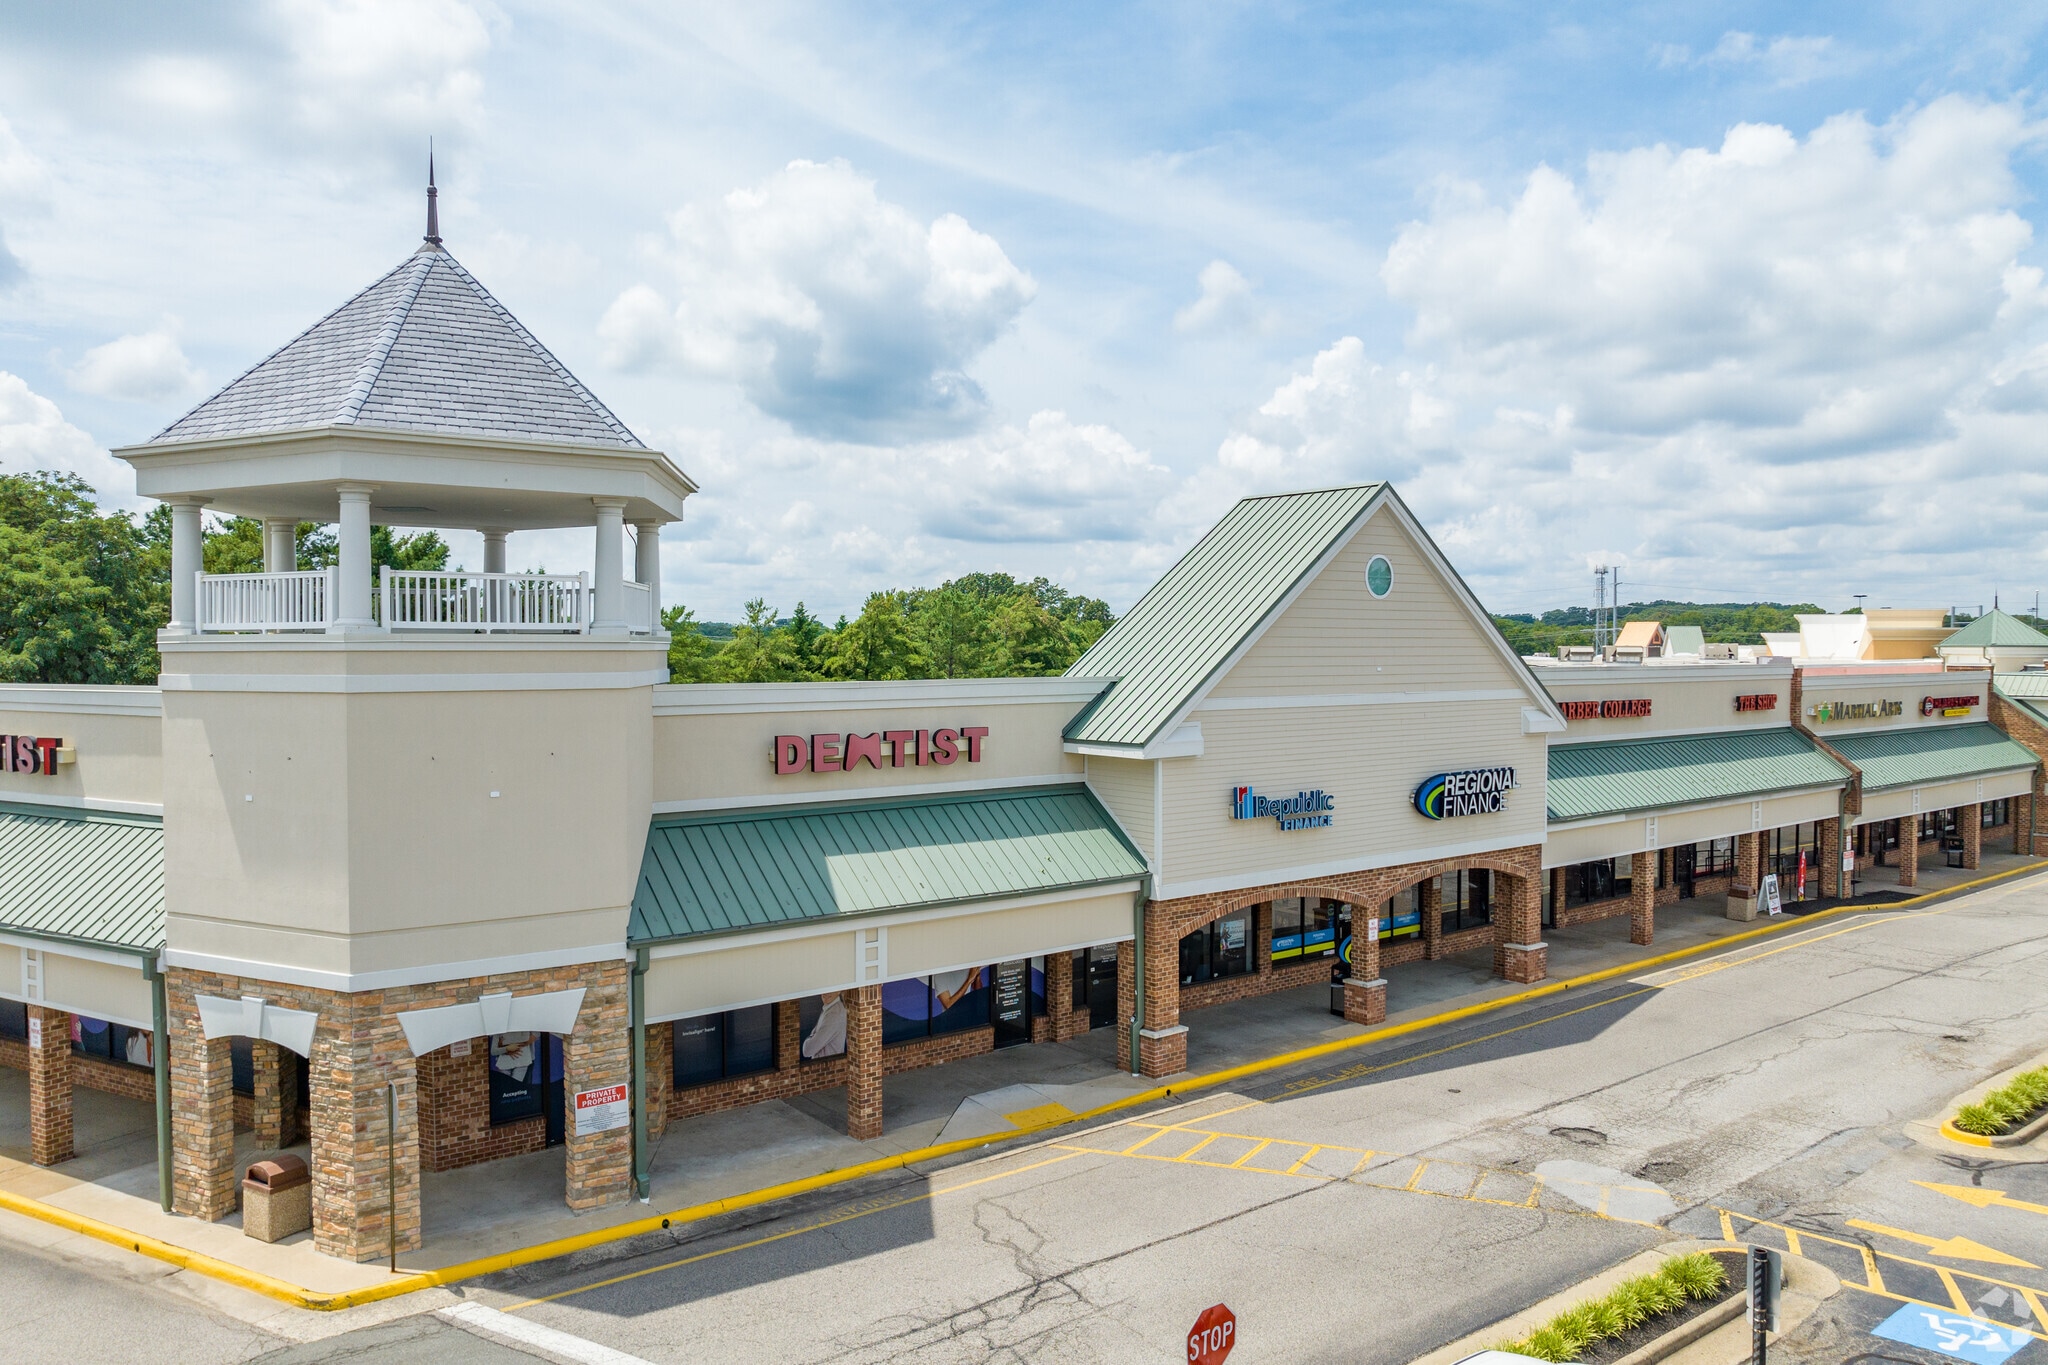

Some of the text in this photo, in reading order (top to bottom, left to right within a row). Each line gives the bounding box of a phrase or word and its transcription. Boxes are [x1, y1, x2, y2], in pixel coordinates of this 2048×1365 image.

[1560, 699, 1652, 720] ARBER COLLEGE
[1739, 694, 1777, 711] THE SHOP
[0, 735, 63, 776] IST
[774, 727, 989, 775] DENTIST
[1444, 768, 1521, 797] REGIONAL
[1257, 790, 1335, 821] Republic
[1443, 791, 1508, 818] FINANCE
[1282, 815, 1333, 831] FINANCE
[502, 1090, 528, 1098] Accepting
[582, 1094, 621, 1107] PROPERTY
[586, 1088, 617, 1100] PRIVATE
[1190, 1321, 1233, 1361] STOP
